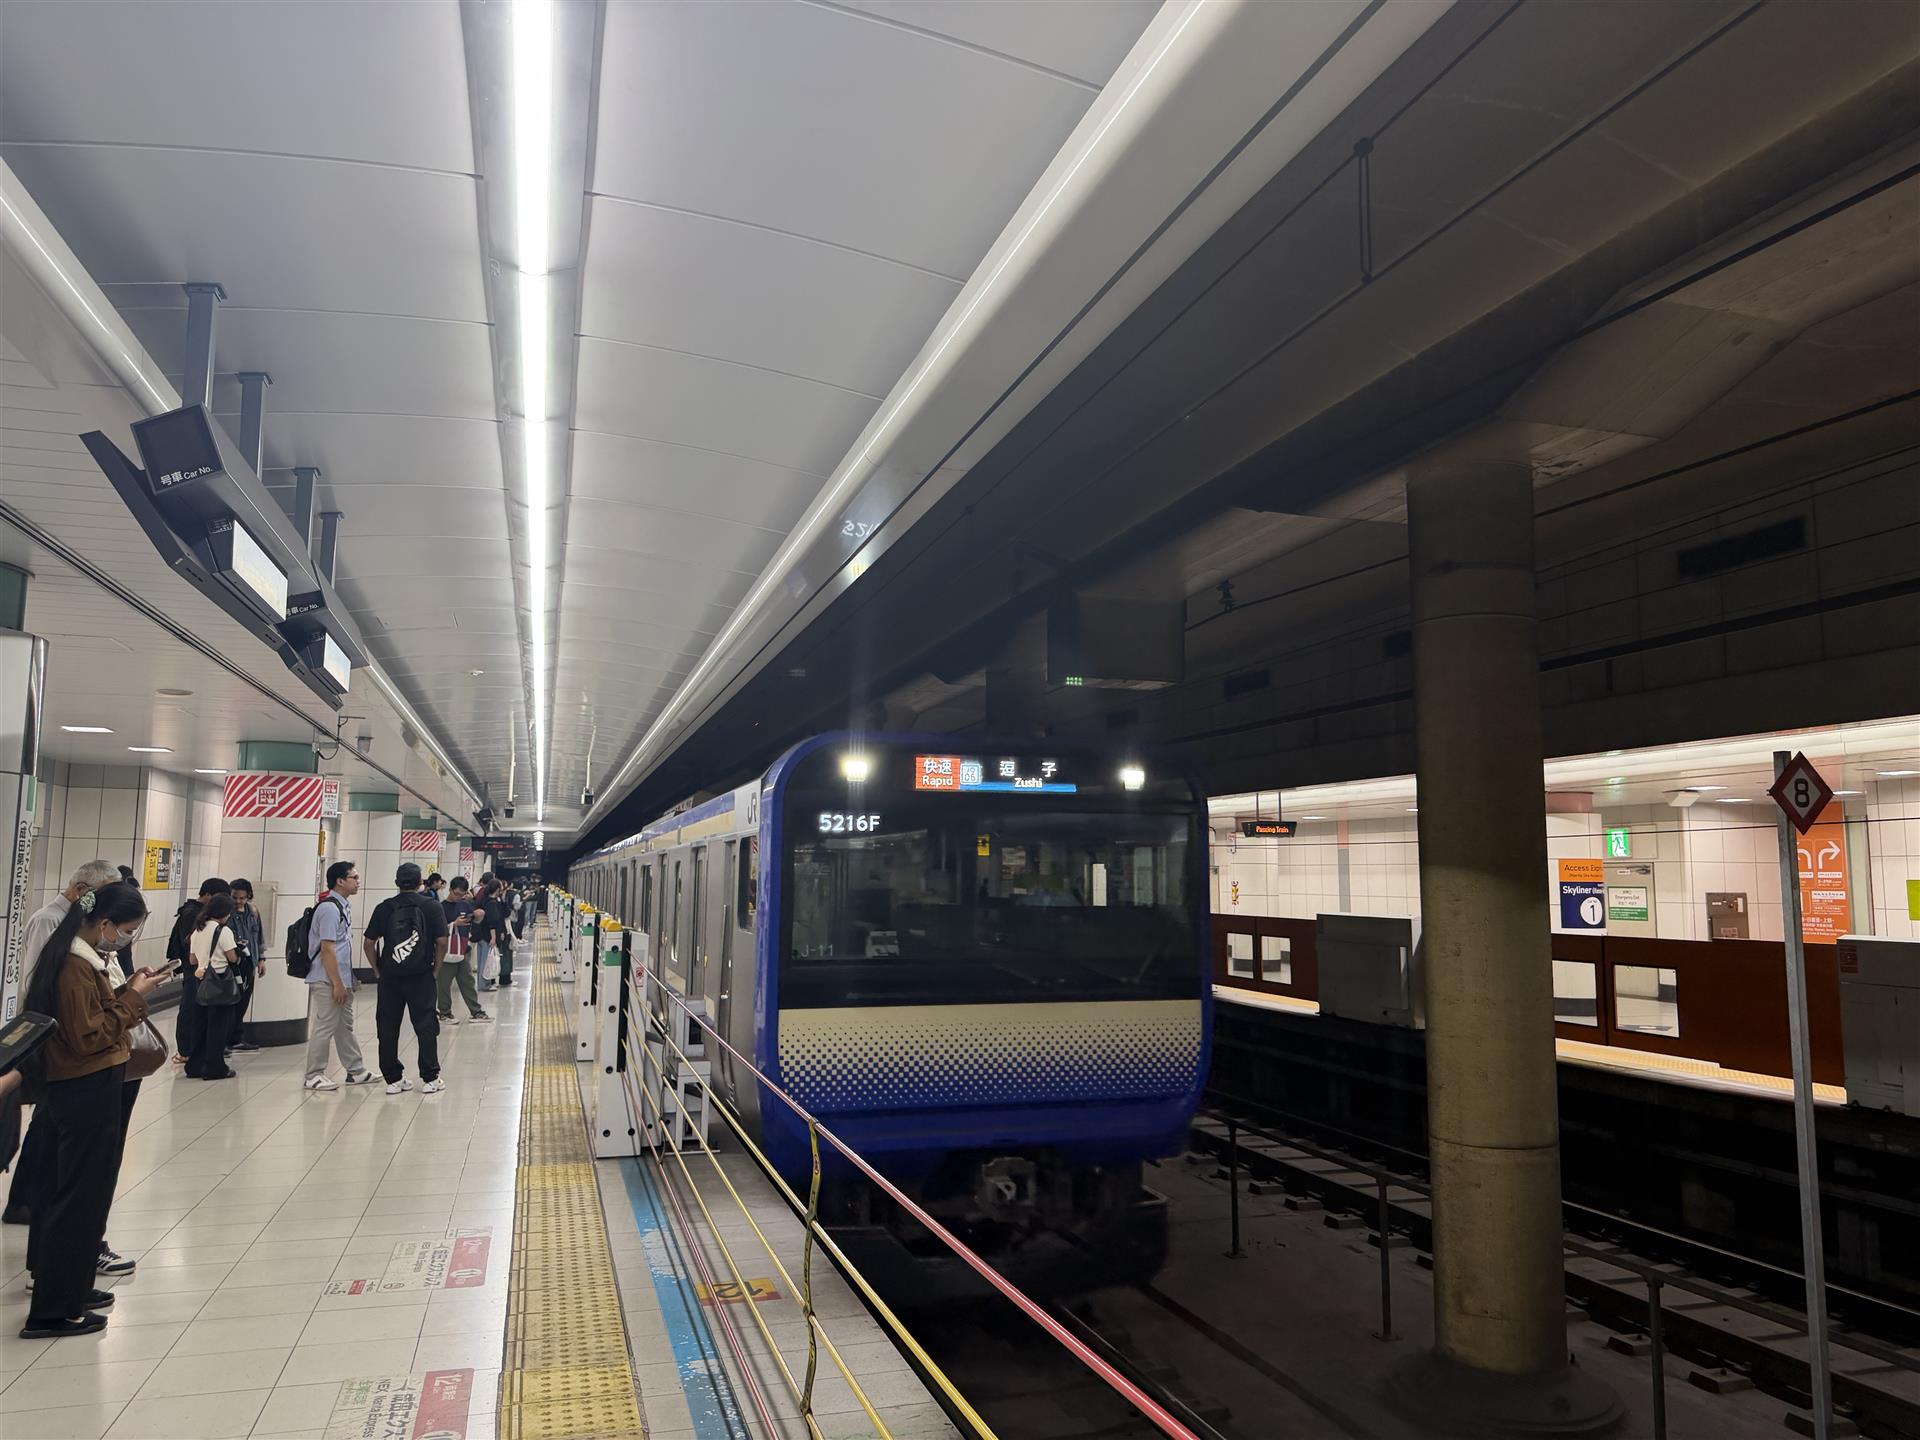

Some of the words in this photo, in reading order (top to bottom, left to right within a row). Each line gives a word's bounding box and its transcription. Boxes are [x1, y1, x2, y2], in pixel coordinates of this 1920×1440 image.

[160, 471, 183, 486] 号車
[183, 471, 197, 480] Car
[198, 466, 213, 475] No.
[923, 759, 952, 775] 快速
[922, 776, 953, 788] Rapid
[1014, 777, 1043, 789] Zushi
[1794, 778, 1810, 808] 8
[747, 791, 757, 825] JR
[819, 814, 881, 832] 5216F
[1256, 825, 1275, 834] Passing
[1276, 825, 1289, 833] Train
[1564, 864, 1590, 872] Access
[1562, 885, 1592, 896] Skyliner
[1590, 904, 1596, 922] 1
[362, 1413, 379, 1438] Express
[381, 1393, 416, 1440] 成田エクス
